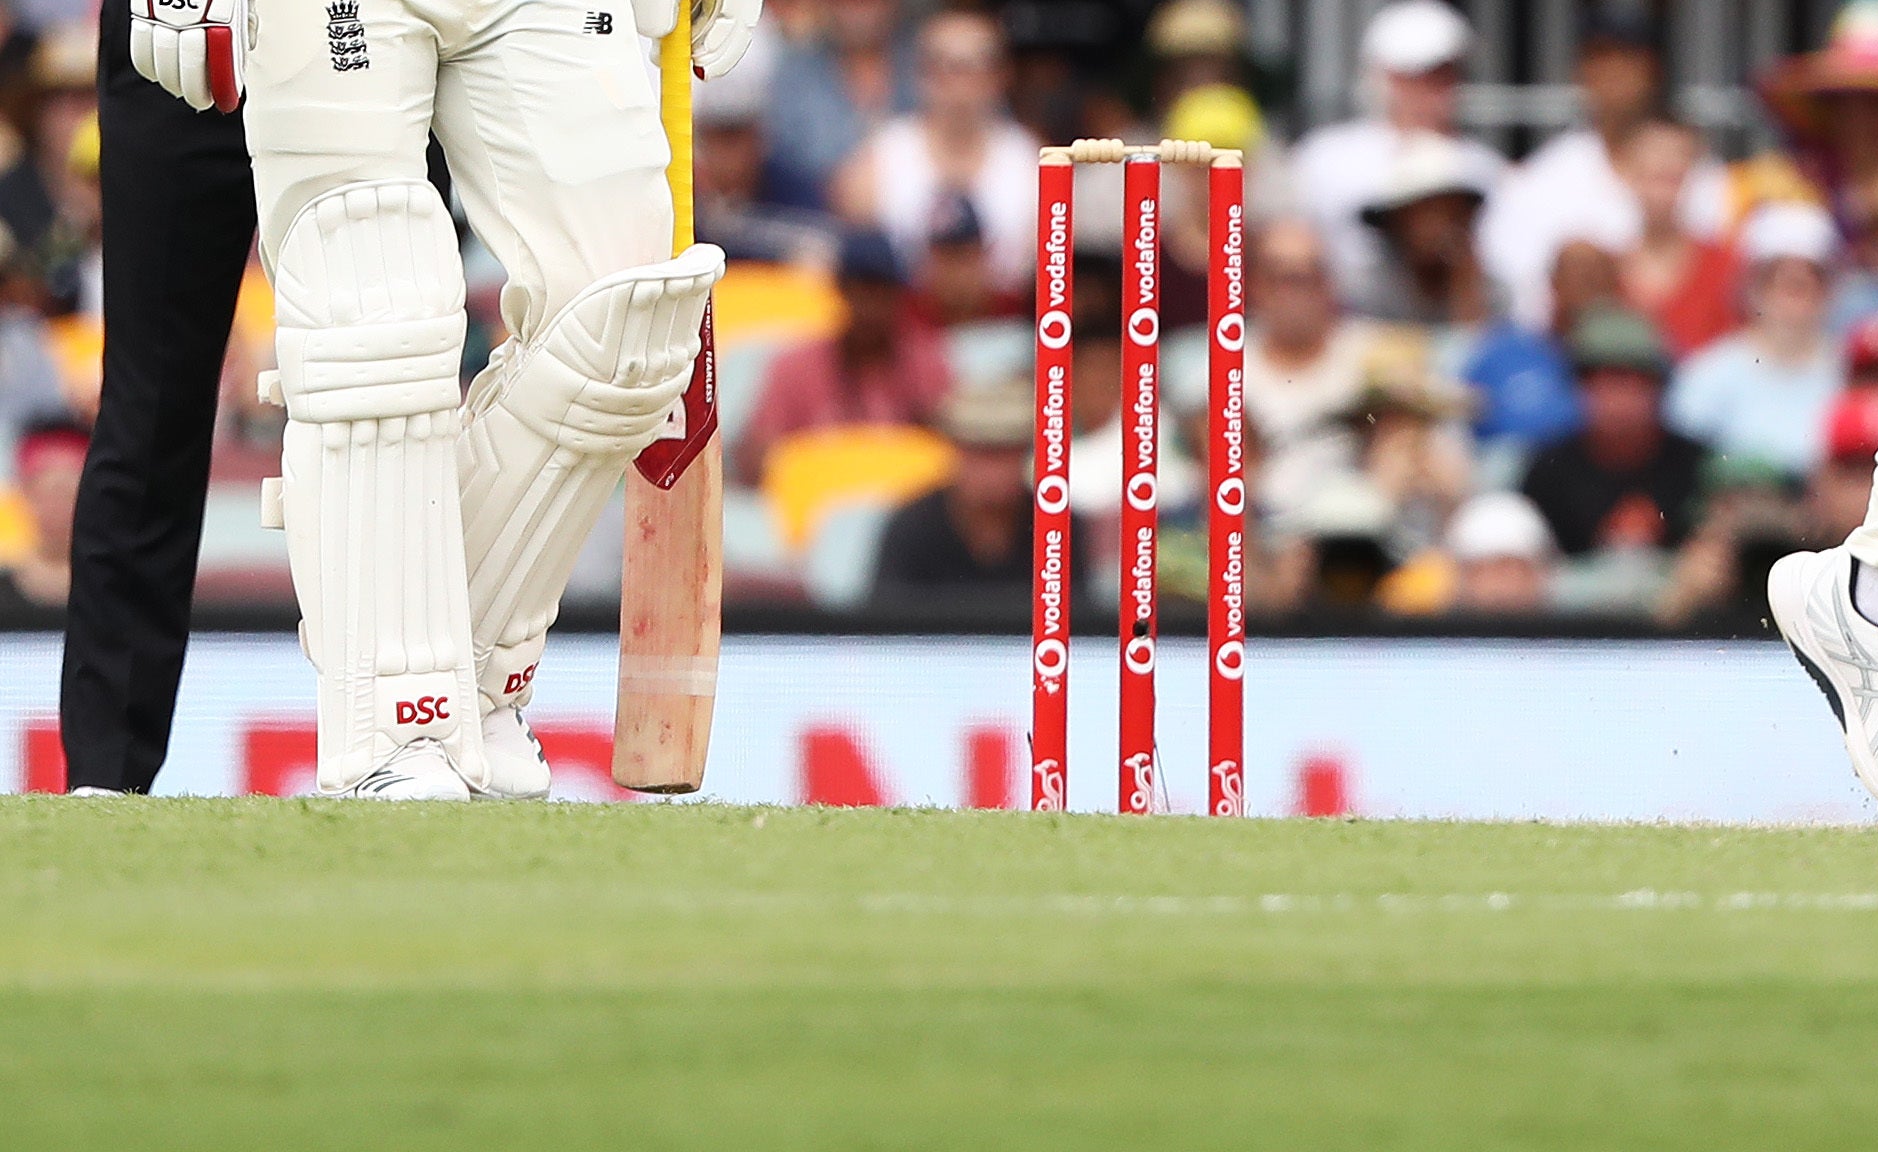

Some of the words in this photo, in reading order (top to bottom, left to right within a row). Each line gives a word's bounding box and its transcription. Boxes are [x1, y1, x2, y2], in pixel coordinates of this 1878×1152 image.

[1046, 201, 1067, 306] vodafone
[1134, 199, 1155, 304] vodafone
[1223, 204, 1242, 309] vodafone
[1042, 364, 1065, 471] vodafone
[1133, 362, 1154, 469] vodafone
[1222, 368, 1242, 473] vodafone
[1041, 529, 1063, 635] vodafone
[1132, 526, 1153, 623] odafone
[1223, 531, 1242, 637] vodafone
[396, 695, 450, 725] DSC
[503, 661, 540, 694] DS
